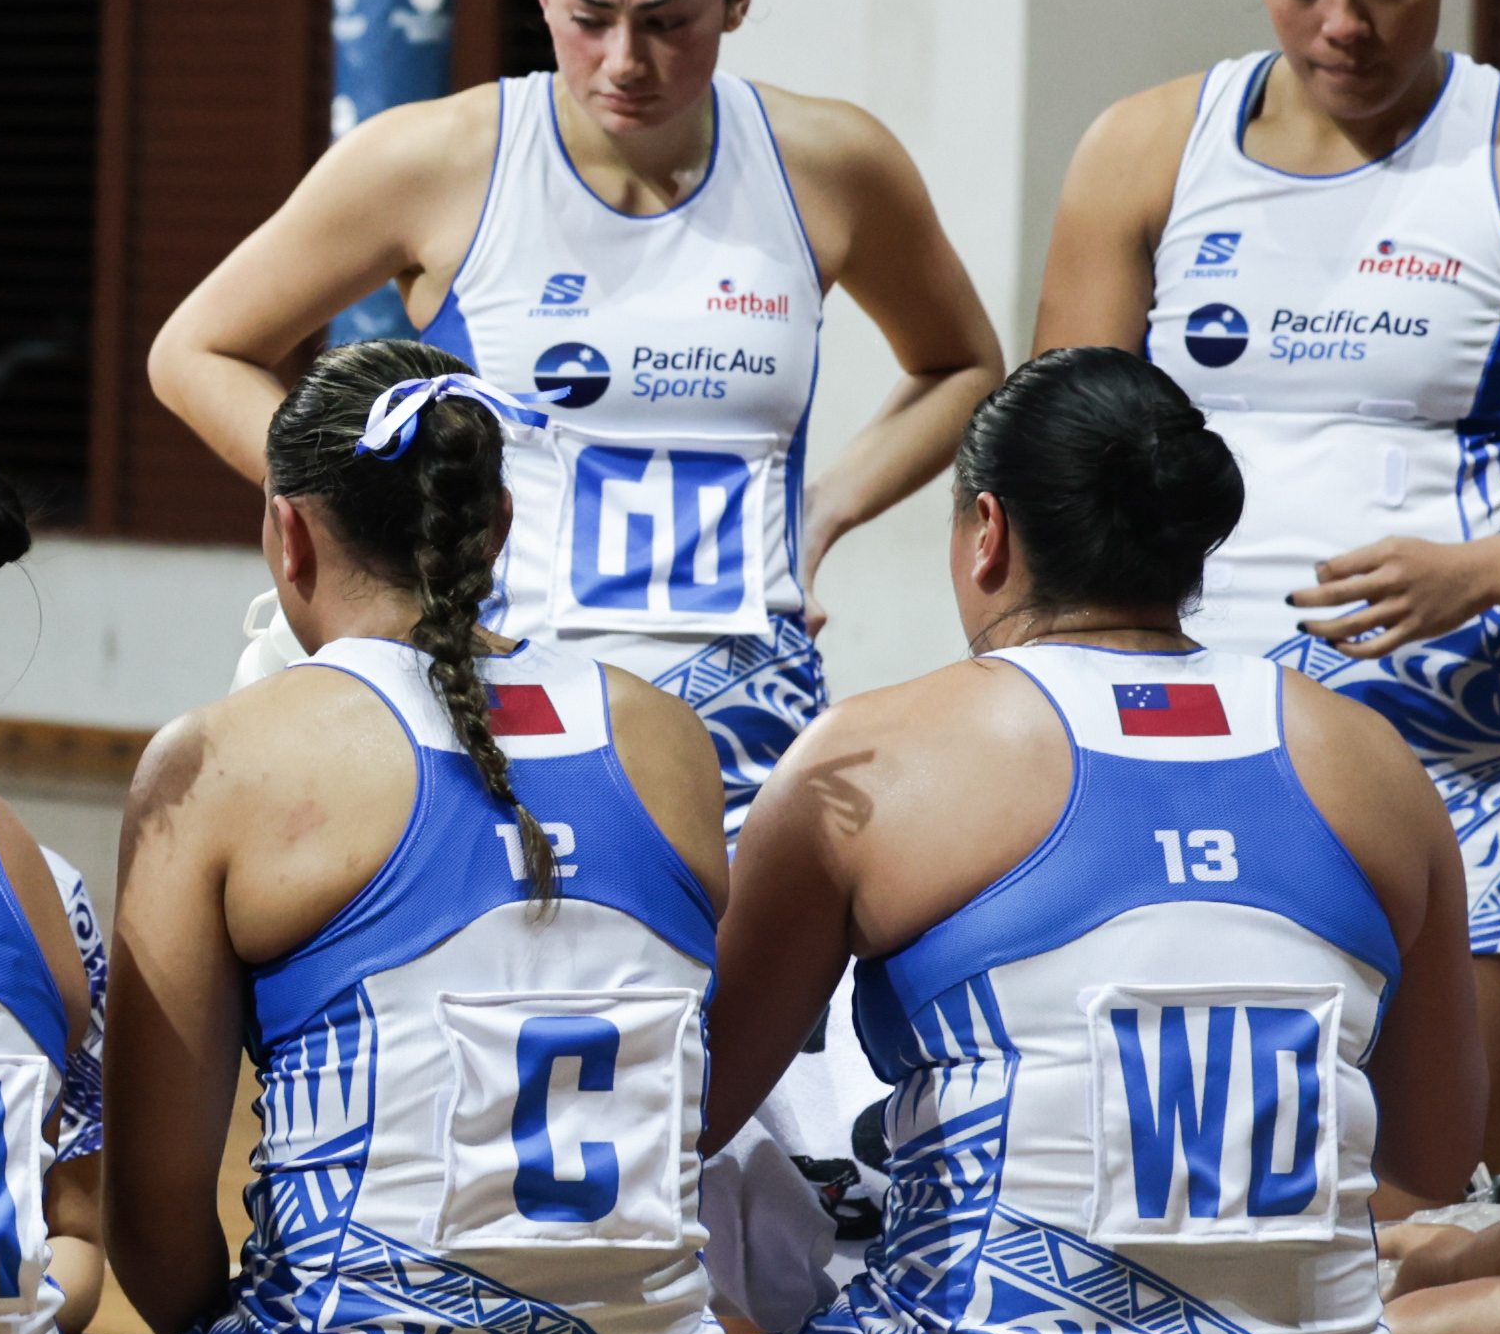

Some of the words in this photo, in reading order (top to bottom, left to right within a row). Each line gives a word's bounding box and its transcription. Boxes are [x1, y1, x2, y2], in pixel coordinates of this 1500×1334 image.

[1358, 255, 1462, 279] netball
[528, 308, 590, 318] STRUDDYS
[707, 293, 789, 315] netball
[1270, 309, 1430, 337] PacificAus
[632, 346, 776, 376] PacificAus
[1270, 335, 1367, 364] Sports
[631, 372, 728, 402] Sports
[571, 445, 754, 615] GD
[1154, 829, 1239, 884] 13
[511, 1016, 620, 1223] C
[1110, 1005, 1321, 1219] WD
